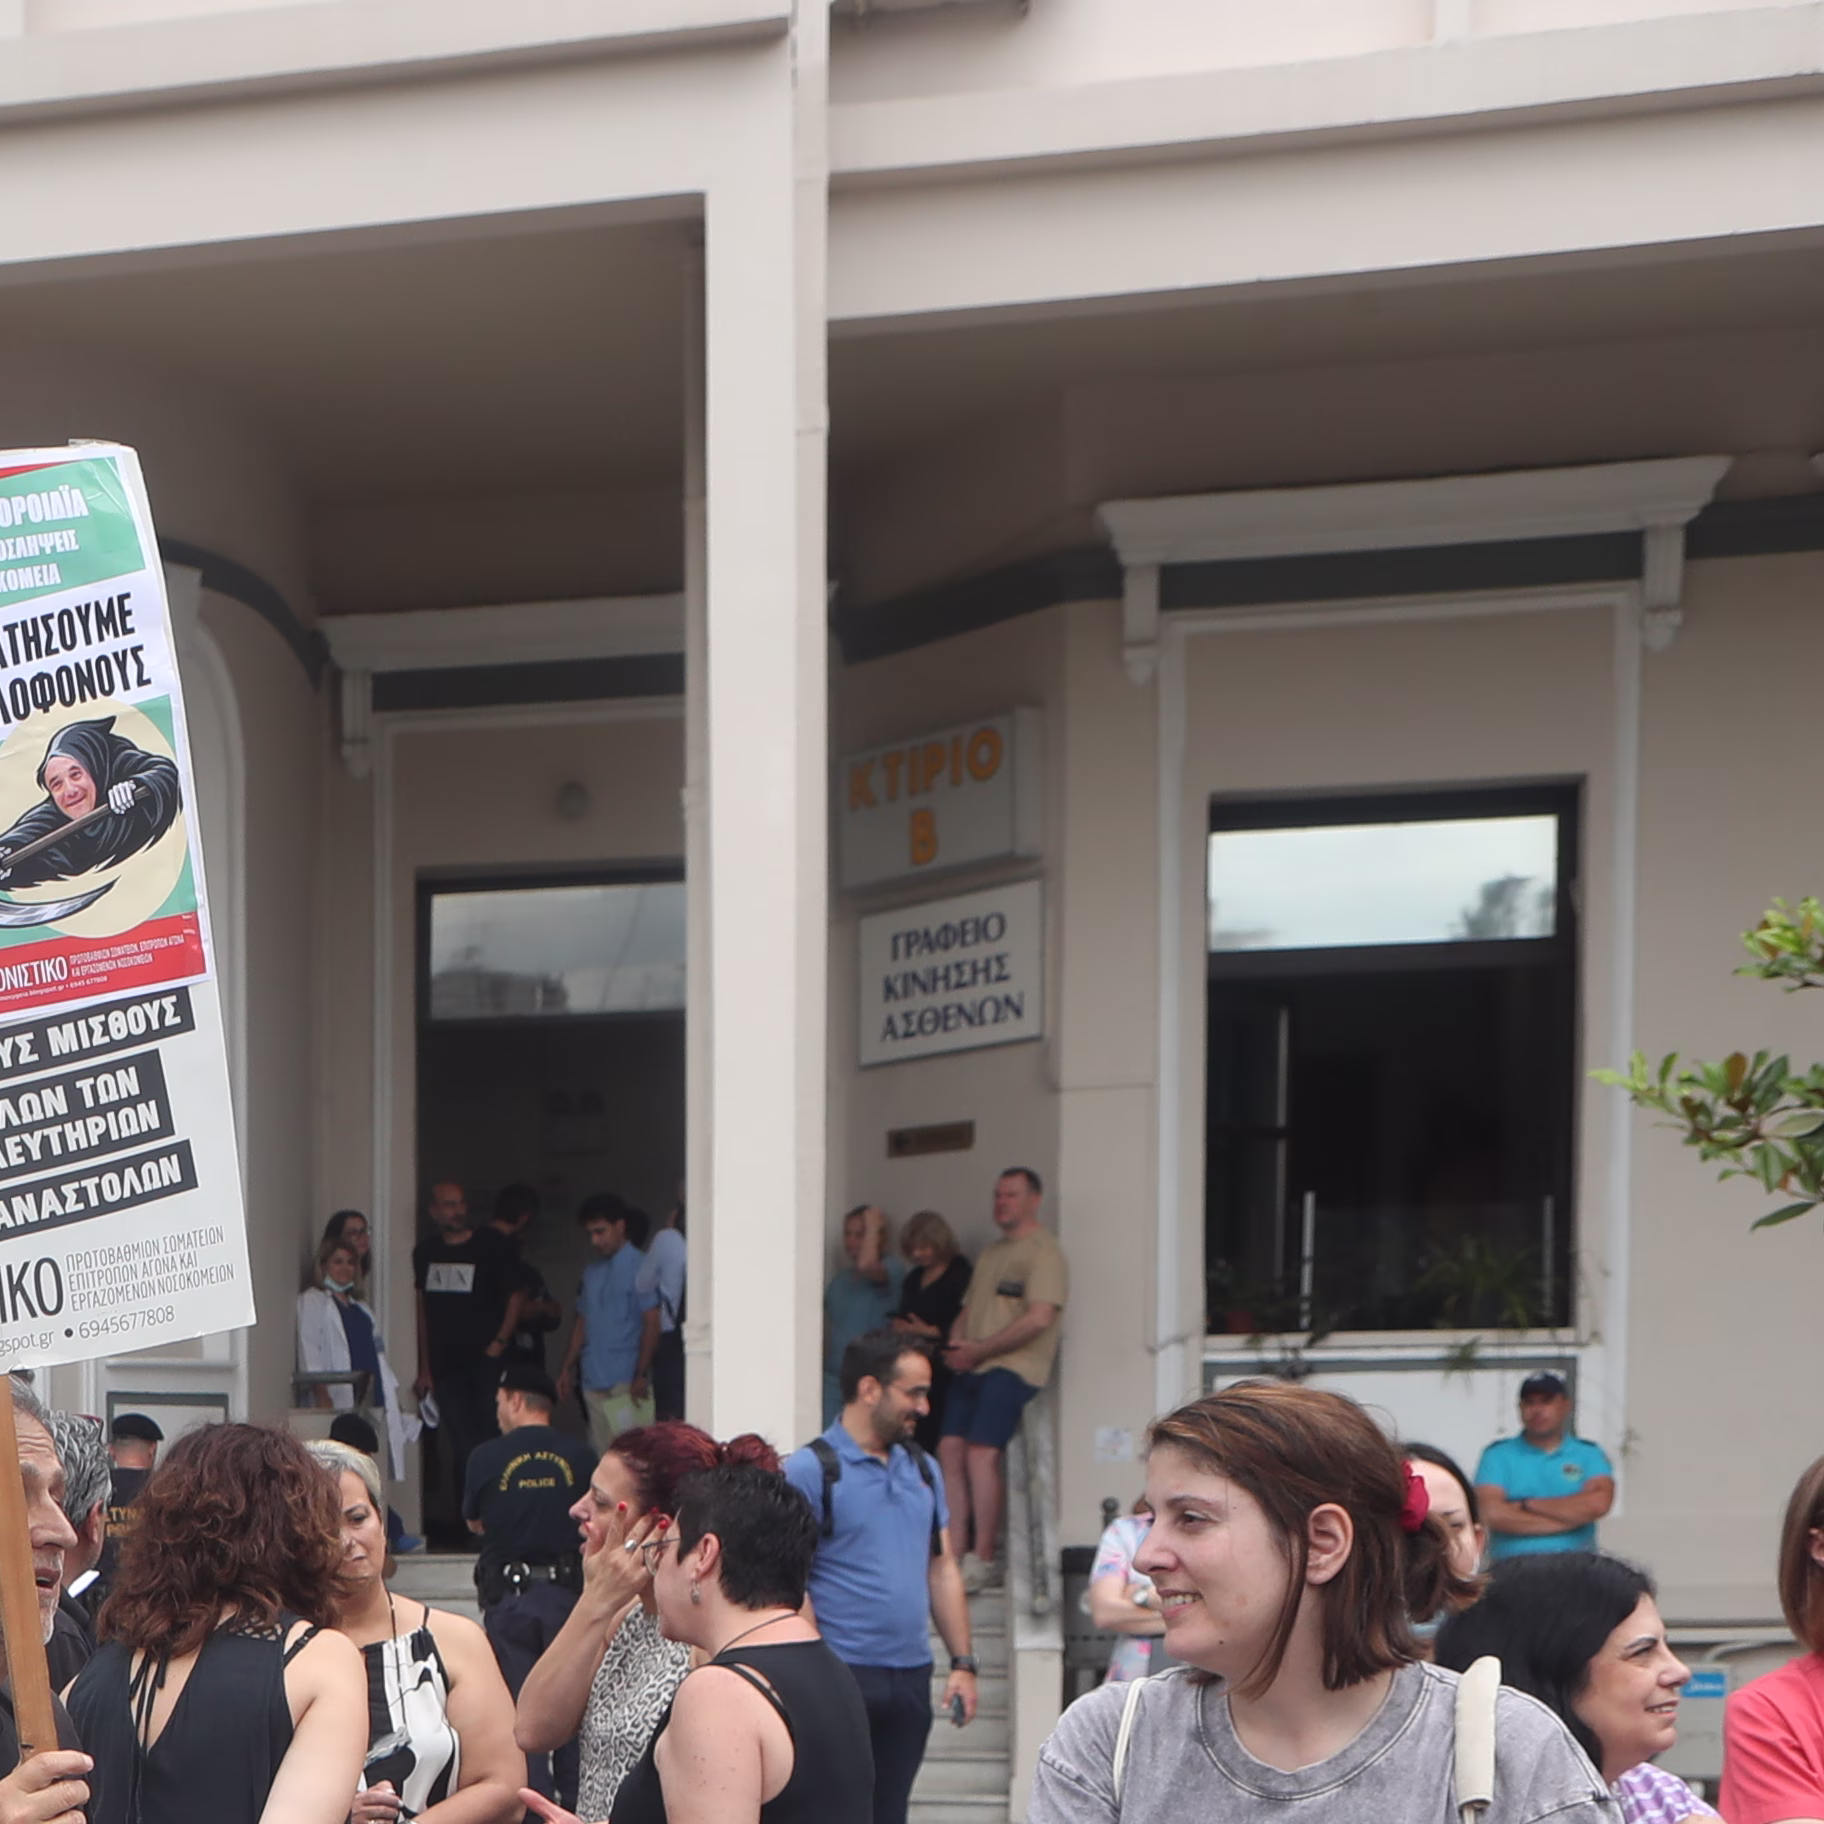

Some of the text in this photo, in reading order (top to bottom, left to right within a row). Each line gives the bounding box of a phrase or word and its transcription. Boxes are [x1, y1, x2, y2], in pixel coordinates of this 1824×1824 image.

[848, 727, 1003, 810] ΚΤΙΡΙΟ
[909, 808, 938, 866] Β
[890, 912, 1007, 961] ΓΡΑΦΕΙΟ
[882, 952, 1012, 1002] ΚΙΝΗΣΗΣ
[47, 995, 181, 1057] ΜΙΣΘΟΥΣ
[880, 991, 1026, 1043] ΑΣΘΕΝΩΝ
[76, 1066, 141, 1111] ΤΩΝ
[66, 1225, 224, 1273] ΠΡΩΤΟΒΑΘΜΙΩΝ ΣΩΜΑΤΕΙΩΝ
[69, 1250, 198, 1293] ΕΠΙΤΡΟΠΩΝ ΑΓΩΝΑ ΚΑΙ
[71, 1263, 235, 1312] ΕΡΓΑΖΟΜΕΝΩΝ ΝΟΣΟΚΟΜΕΙΩΝ
[79, 1305, 175, 1339] 6945677808
[518, 1477, 556, 1489] POLICE
